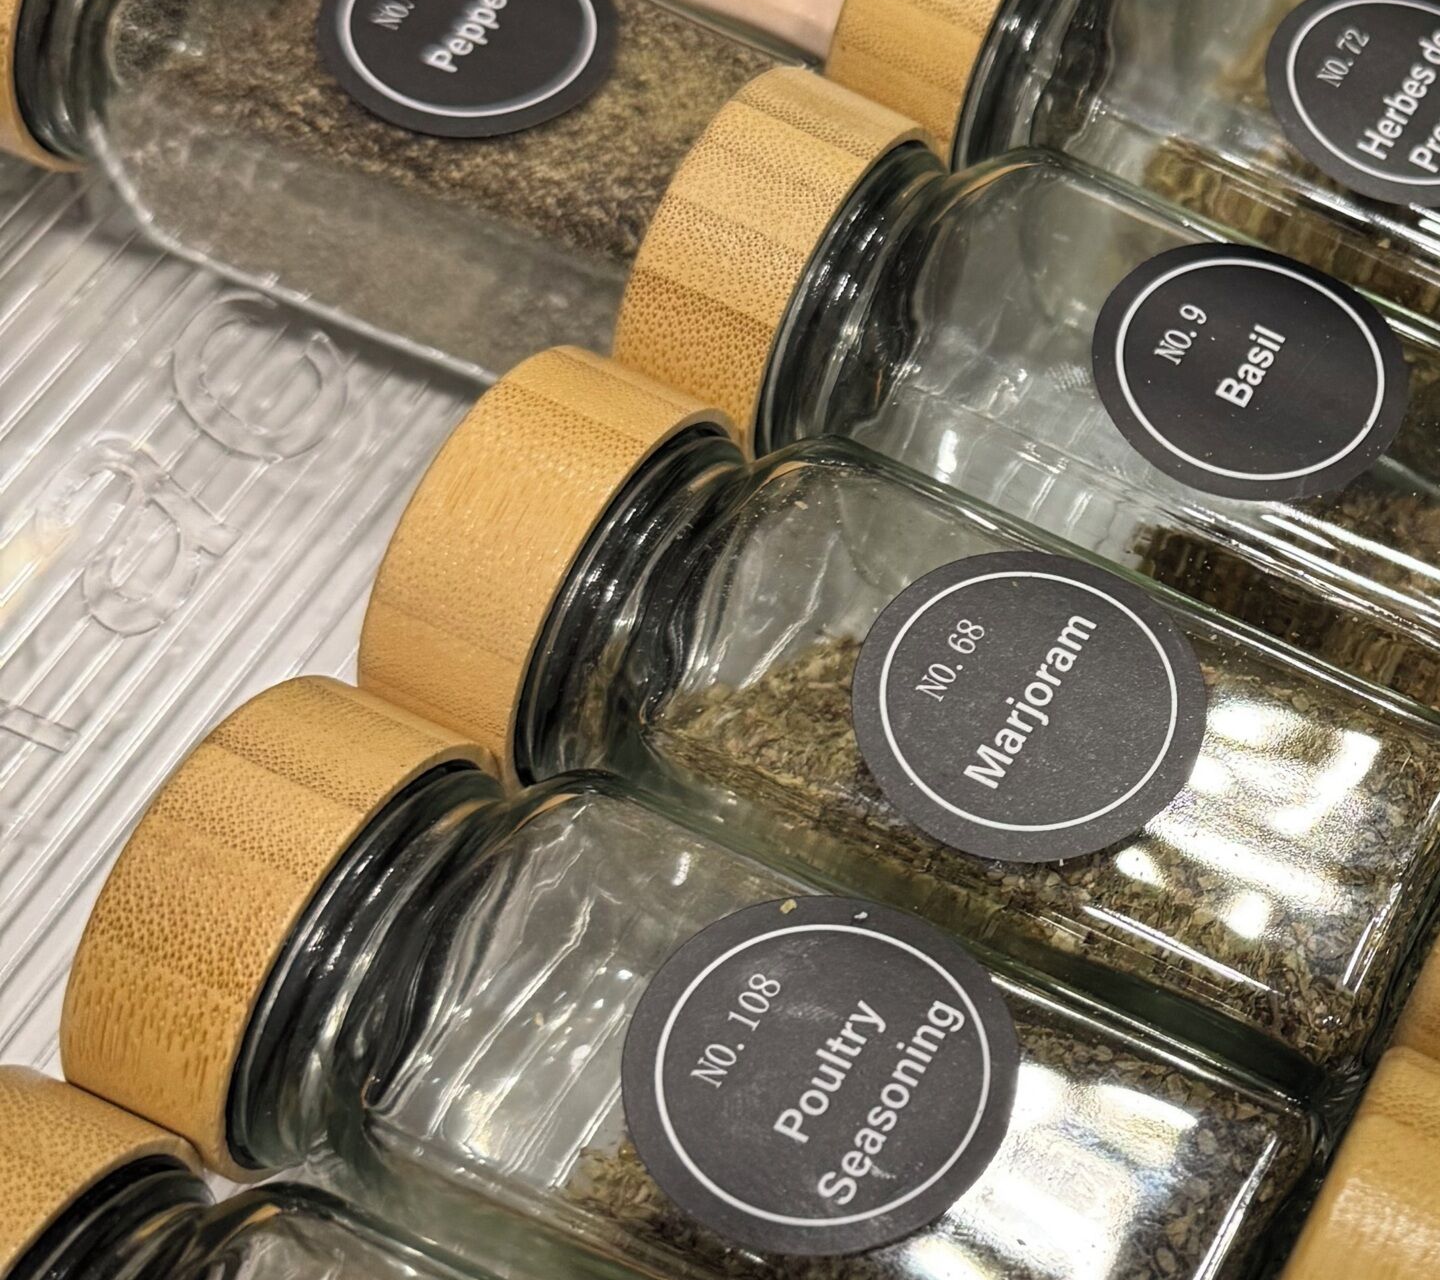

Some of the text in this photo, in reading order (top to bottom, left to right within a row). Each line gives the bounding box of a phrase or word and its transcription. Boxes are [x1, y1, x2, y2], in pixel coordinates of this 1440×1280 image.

[371, 1, 415, 31] NO.
[1316, 28, 1370, 88] NO. 72
[1356, 64, 1436, 161] Herbes
[1153, 304, 1207, 366] NO. 9
[1215, 324, 1286, 408] Basil
[915, 618, 985, 703] NO. 68
[962, 615, 1097, 790] Marjoram
[690, 973, 781, 1089] NO. 108
[773, 999, 887, 1144] Poultry
[816, 1000, 979, 1206] Seasoning
